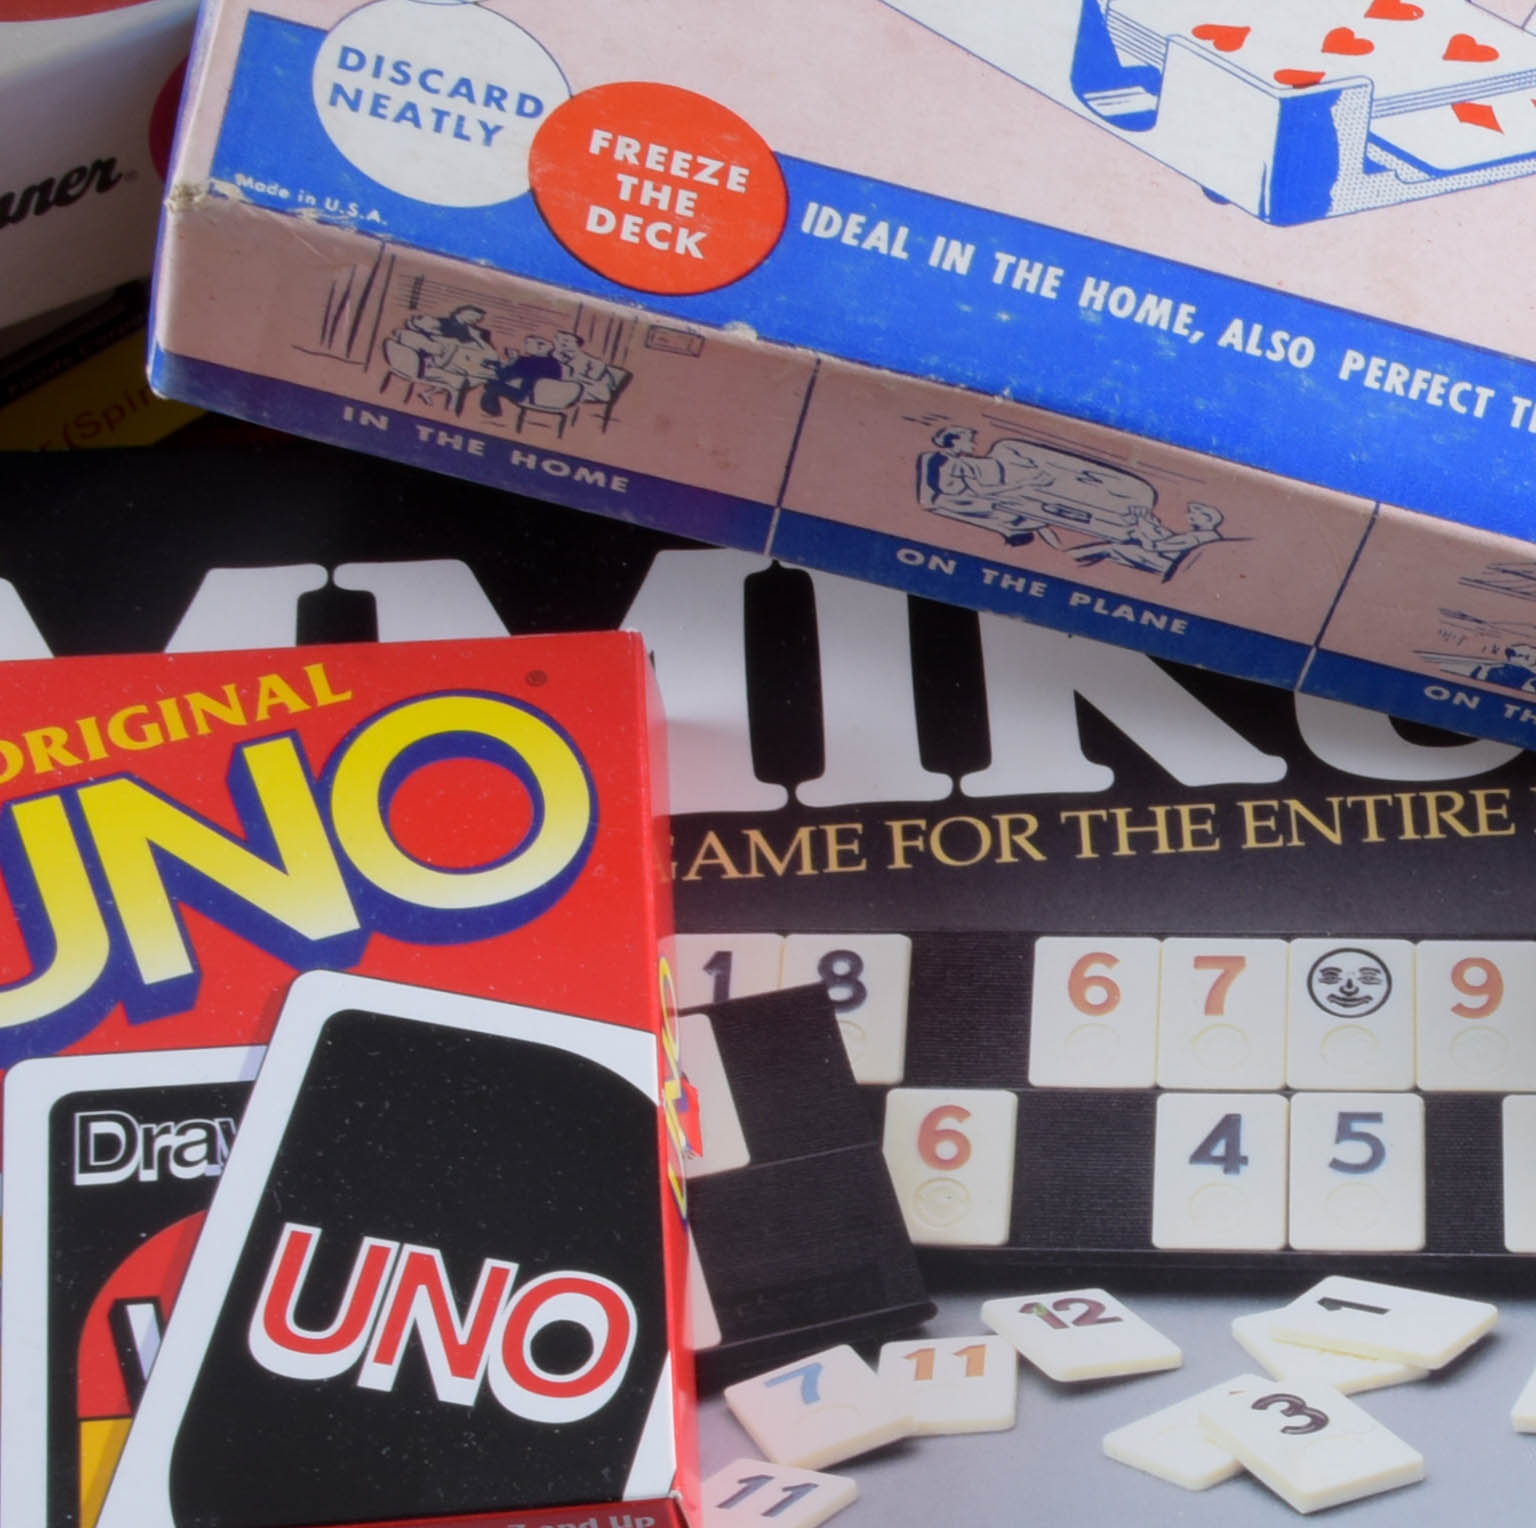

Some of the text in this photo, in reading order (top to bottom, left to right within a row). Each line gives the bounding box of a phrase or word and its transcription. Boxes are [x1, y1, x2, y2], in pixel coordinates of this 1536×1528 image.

[338, 45, 543, 119] DISCARD
[328, 83, 504, 148] NEATLY
[589, 129, 750, 194] FREEZE
[236, 173, 388, 226] Made in U.S.A.
[616, 173, 695, 217] THE
[586, 205, 707, 258] DECK
[801, 202, 909, 260] IDEAL
[929, 236, 975, 275] IN
[992, 251, 1064, 300] THE
[1079, 280, 1204, 343] HOME,
[1218, 319, 1315, 369] ALSO
[1339, 349, 1494, 418] PERFECT
[343, 405, 629, 492] IN THE HOME
[896, 547, 1190, 636] ON THE PLANE
[1423, 685, 1480, 711] ON
[885, 811, 1047, 871] FOR
[1060, 803, 1221, 859] THE
[1237, 787, 1516, 850] ENTIRE
[1067, 951, 1121, 1017] 6
[1193, 955, 1246, 1017] 7
[1450, 957, 1505, 1019] 9
[247, 1222, 638, 1424] UNO
